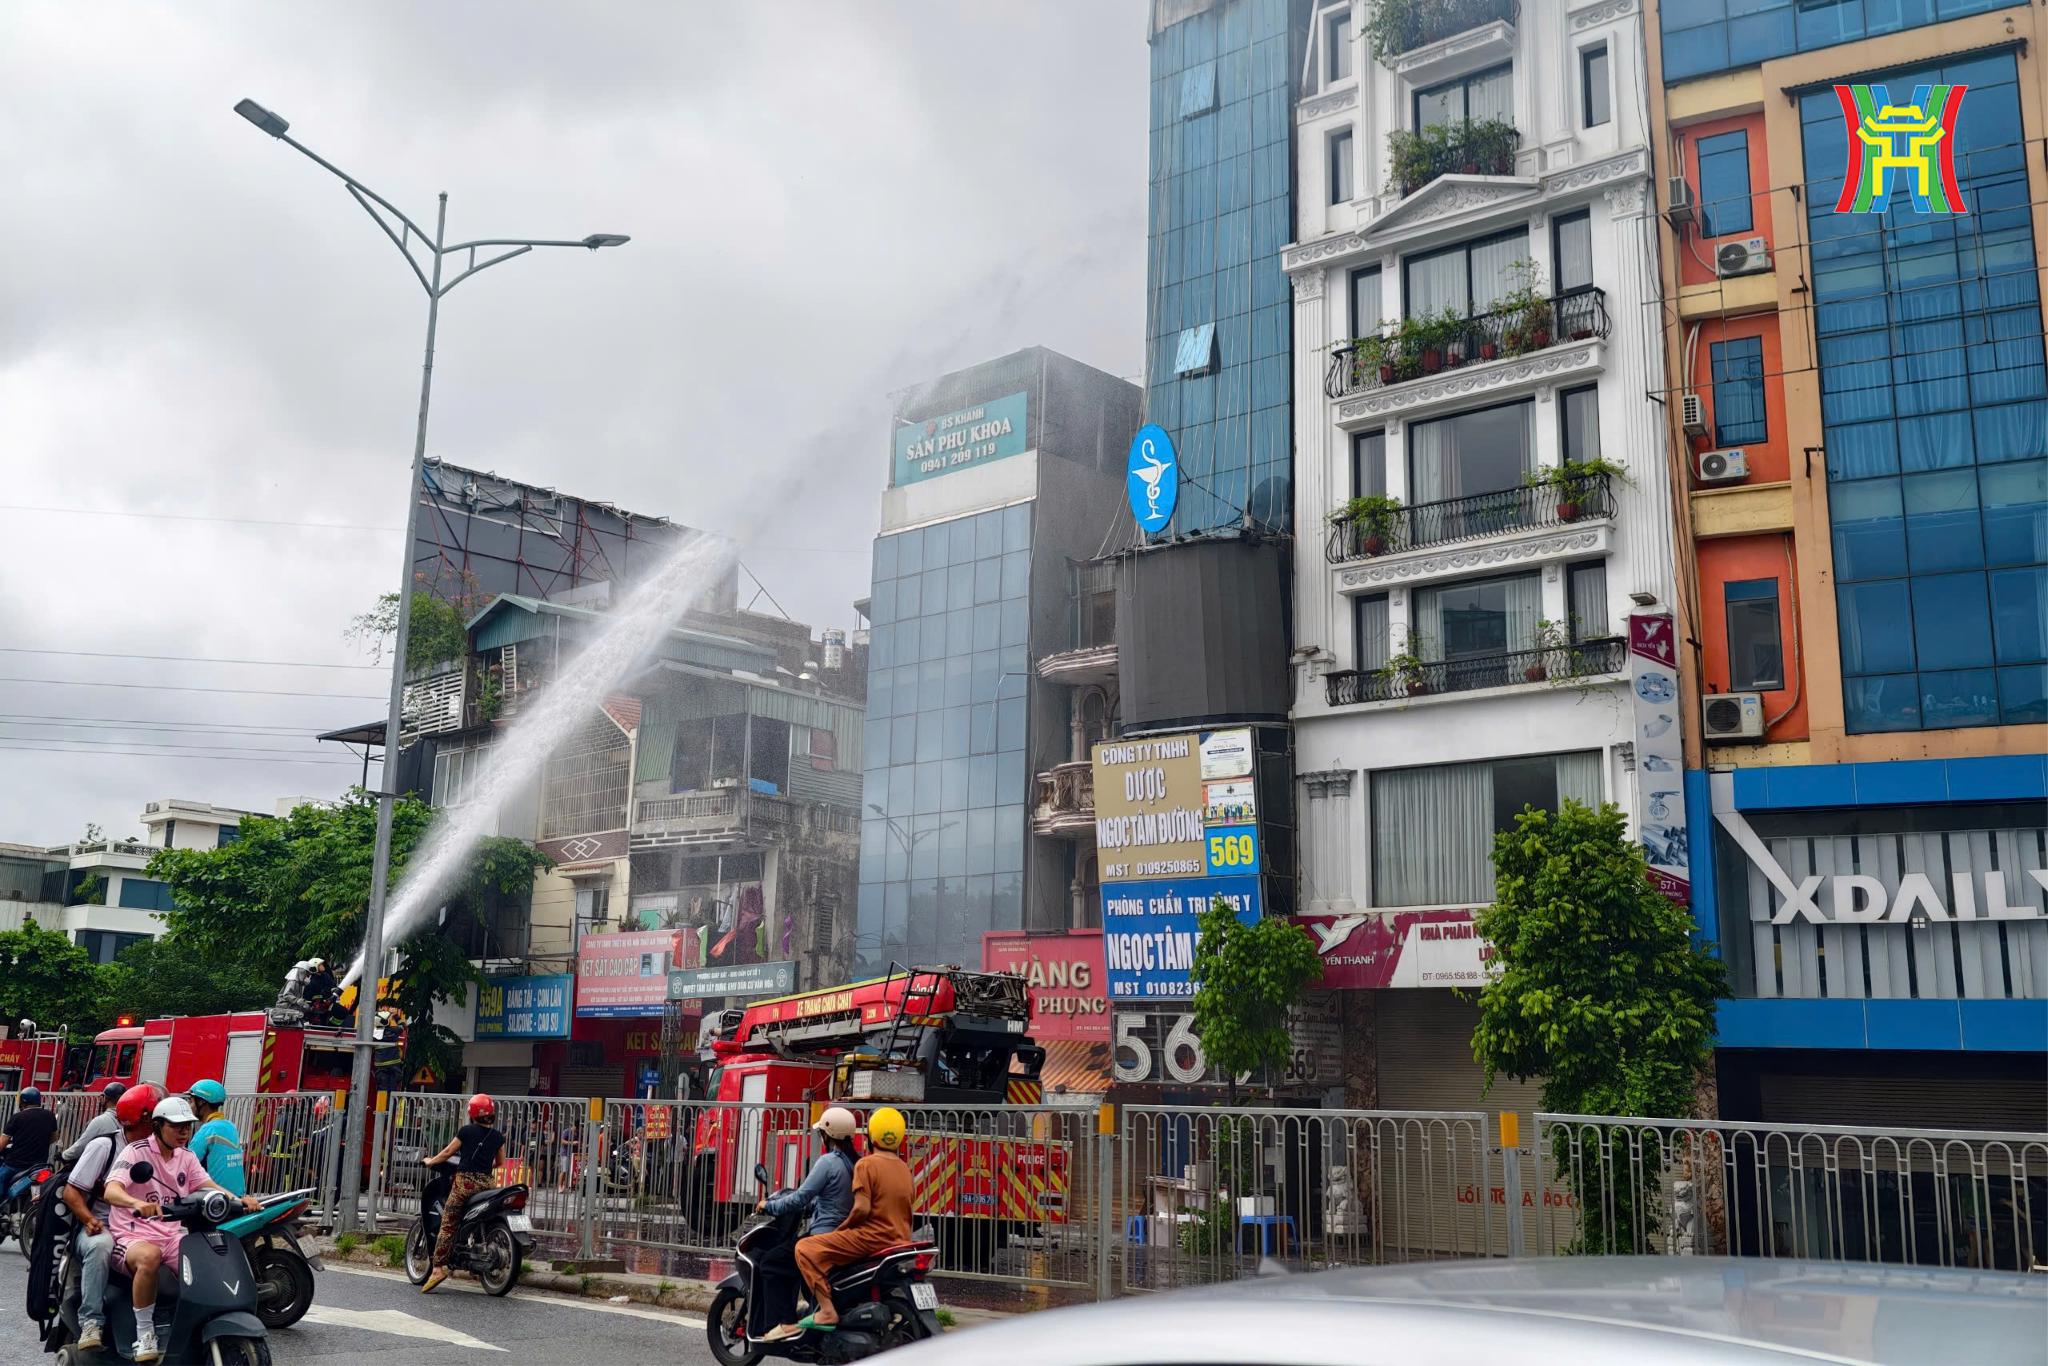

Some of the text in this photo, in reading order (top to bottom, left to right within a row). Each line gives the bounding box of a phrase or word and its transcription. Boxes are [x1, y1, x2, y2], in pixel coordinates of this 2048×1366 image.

[941, 407, 984, 429] BS KHANH
[906, 435, 935, 461] SẢN
[970, 417, 1012, 443] KHOA
[921, 443, 995, 473] 0941 209 119
[1101, 739, 1189, 766] CÔNG TY TNHH
[1125, 767, 1166, 805] DƯỢC
[1097, 805, 1205, 852] NGỌC TÂM ĐƯỜNG
[1210, 835, 1254, 867] 569
[1106, 859, 1201, 878] MST 0109250865
[1661, 880, 1676, 890] 571
[1107, 894, 1144, 916] PHÒNG
[1149, 889, 1183, 915] CHẨN
[1243, 894, 1251, 912] Y
[1420, 924, 1442, 942] NHÀ
[1443, 923, 1472, 941] PHÂN
[1107, 932, 1155, 976] NGỌC
[1155, 925, 1193, 970] TÂM
[1325, 953, 1374, 966] YẾN THANH
[609, 958, 622, 976] CAO
[1422, 972, 1435, 981] ĐT:
[1436, 971, 1478, 981] 0965.158.188
[1114, 981, 1139, 995] MST
[479, 986, 503, 1017] 559A
[537, 988, 549, 1008] CON
[1038, 996, 1106, 1019] PHỤNG
[508, 1013, 533, 1032] SILICONE
[537, 1012, 550, 1032] CAO
[550, 1012, 559, 1032] SU
[1007, 1020, 1024, 1033] HM
[1018, 1154, 1045, 1165] POLICE
